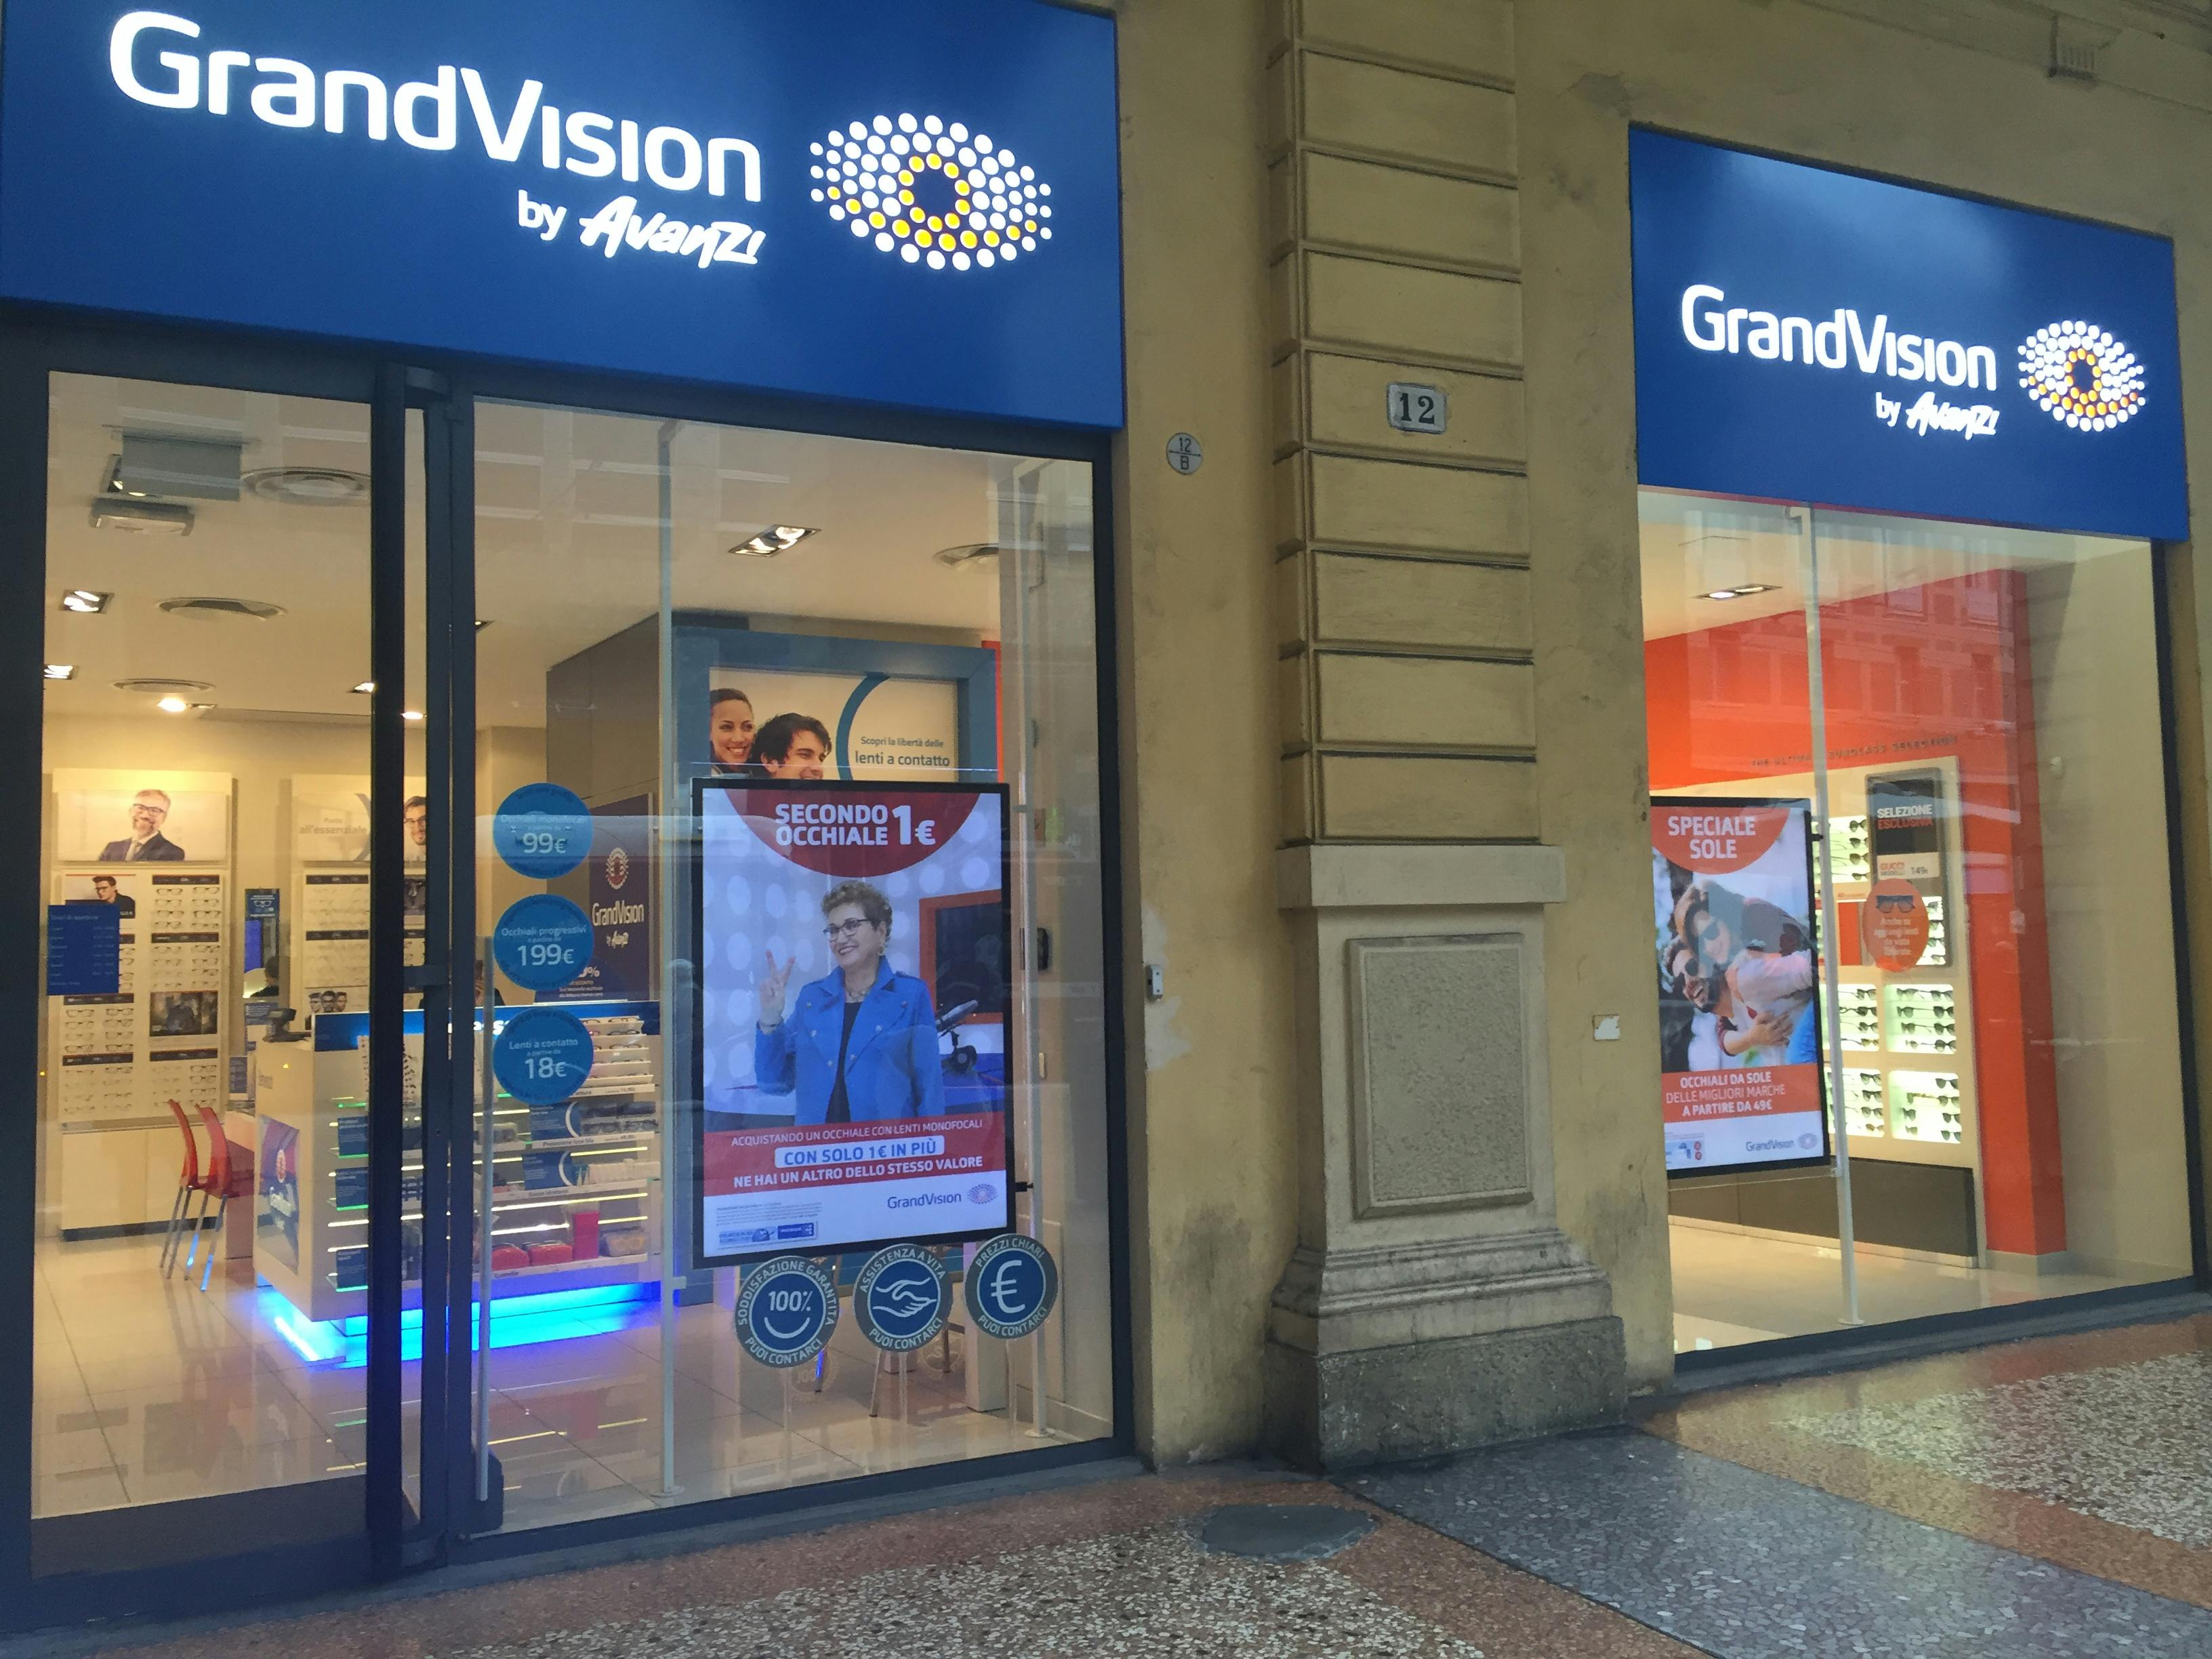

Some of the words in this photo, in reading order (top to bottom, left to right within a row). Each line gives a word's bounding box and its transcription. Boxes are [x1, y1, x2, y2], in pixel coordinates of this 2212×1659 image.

[110, 10, 762, 203] GrandVision
[518, 190, 566, 241] by
[1681, 284, 1997, 391] GrandVision
[1399, 392, 1436, 425] 12
[1876, 392, 1902, 428] by
[1178, 437, 1192, 453] 12
[861, 736, 886, 748] Scopri
[924, 739, 944, 747] delle
[855, 751, 884, 765] lenti
[887, 755, 895, 765] a
[898, 753, 950, 767] contatto
[775, 803, 888, 825] SECONDO
[1877, 804, 1933, 819] SELEZIONE
[775, 825, 888, 846] OCCHIALE
[1668, 815, 1756, 836] SPECIALE
[523, 833, 567, 854] 99€
[1690, 838, 1737, 859] SOLE
[592, 900, 644, 926] GrandVision
[501, 927, 537, 936] Occhiali
[539, 925, 587, 937] progressivi
[517, 944, 575, 966] 199€
[509, 1041, 531, 1050] Lenti
[541, 1038, 578, 1048] contatto
[525, 1057, 567, 1079] 18€
[1680, 1075, 1728, 1089] OCCHIALI
[1730, 1073, 1745, 1084] DA
[1746, 1071, 1771, 1084] SOLE
[1666, 1091, 1697, 1104] DELLE
[1699, 1088, 1744, 1101] MIGLIORI
[1746, 1084, 1786, 1097] MARCHE
[1682, 1106, 1691, 1117] A
[1692, 1103, 1735, 1116] PARTIRE
[1737, 1101, 1752, 1112] DA
[1754, 1100, 1773, 1111] 49€
[731, 1132, 804, 1147] ACQUISTANDO
[806, 1130, 821, 1140] UN
[823, 1127, 871, 1141] OCCHIALE
[872, 1126, 893, 1136] CON
[894, 1123, 921, 1135] LENTI
[923, 1119, 983, 1132] MONOFOCALI
[784, 1151, 817, 1166] CON
[822, 1148, 863, 1163] SOLO
[869, 1145, 887, 1159] 1€
[891, 1144, 904, 1157] IN
[912, 1137, 937, 1155] PIÙ
[1746, 1140, 1795, 1151] GrandVision
[733, 1175, 752, 1188] NE
[754, 1173, 778, 1187] HAI
[781, 1171, 799, 1184] UN
[802, 1167, 843, 1183] ALTRO
[846, 1164, 885, 1179] DELLO
[887, 1160, 934, 1176] STESSO
[936, 1155, 983, 1171] VALORE
[887, 1193, 962, 1210] GrandVision
[976, 1239, 1010, 1268] PREZZI
[1011, 1237, 1046, 1260] CHIARI
[859, 1248, 917, 1293] ASSISTENZA
[917, 1250, 926, 1261] A
[926, 1254, 947, 1280] VITA
[737, 1260, 806, 1326] SODDISFAZIONE
[806, 1263, 836, 1326] GARANTITA
[769, 1290, 812, 1313] 100%
[978, 1315, 1002, 1336] PUOI
[1002, 1307, 1048, 1336] CONTARCI
[869, 1327, 894, 1349] PUOI
[894, 1317, 944, 1350] CONTARCI
[745, 1336, 769, 1362] PUOI
[768, 1338, 823, 1365] CONTARCI
